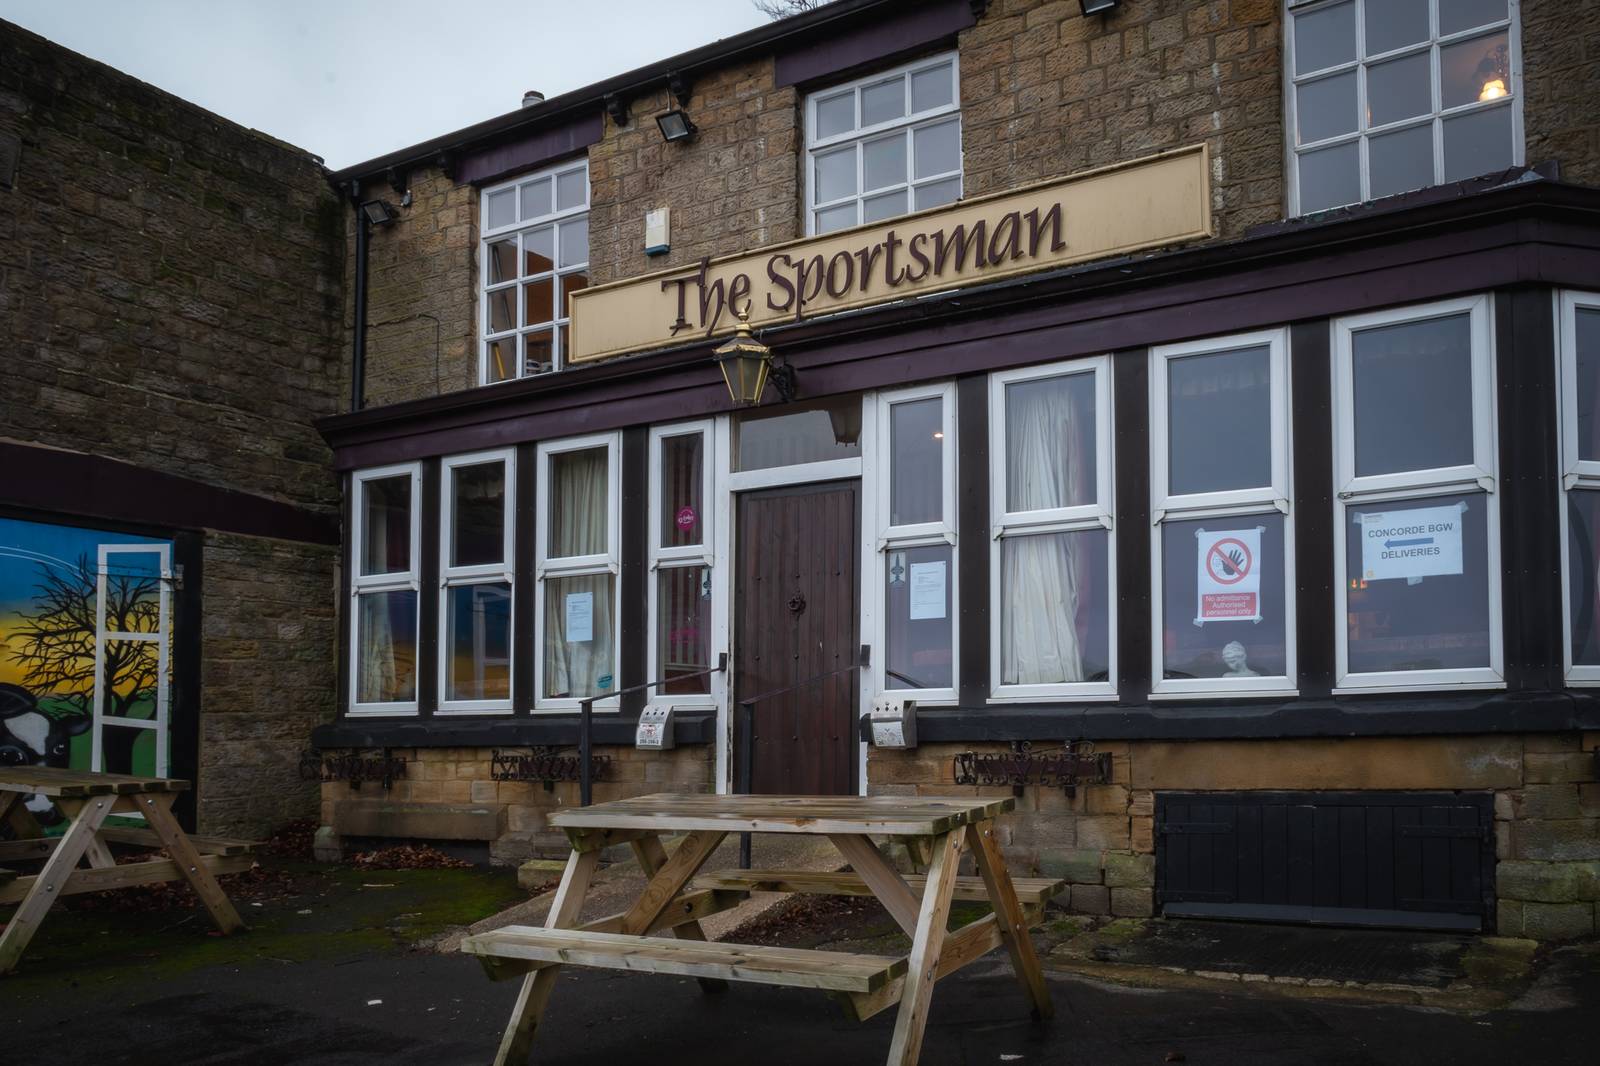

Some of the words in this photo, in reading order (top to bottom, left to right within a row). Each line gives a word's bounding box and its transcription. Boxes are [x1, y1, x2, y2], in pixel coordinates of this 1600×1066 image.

[661, 256, 752, 337] The
[766, 202, 1067, 323] Sportsman
[1368, 525, 1425, 538] CONCORDE
[1428, 522, 1453, 533] BGW
[1381, 546, 1440, 560] DELIVERIES
